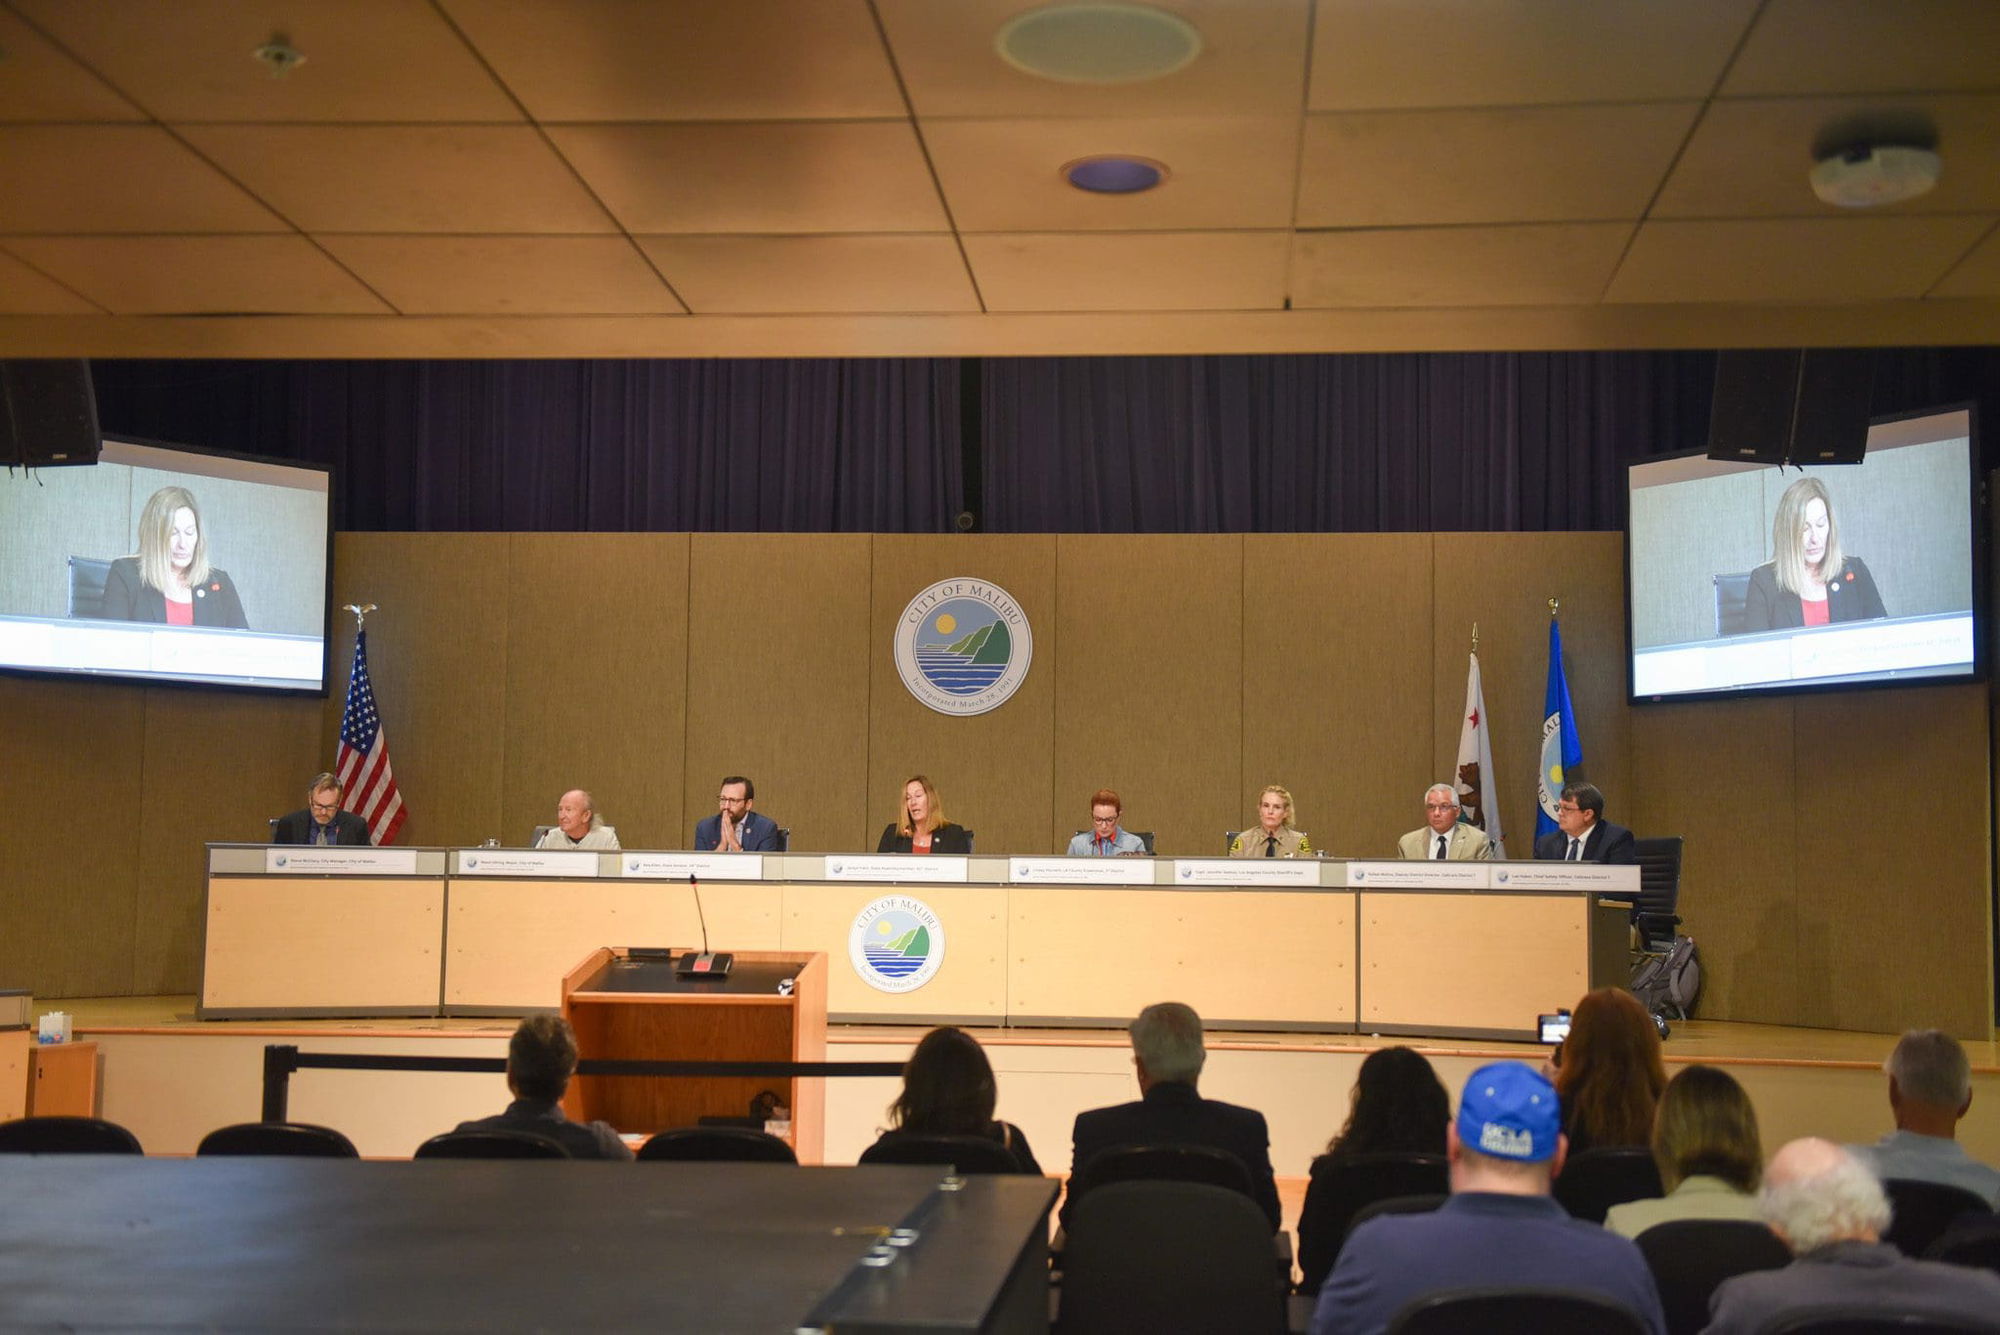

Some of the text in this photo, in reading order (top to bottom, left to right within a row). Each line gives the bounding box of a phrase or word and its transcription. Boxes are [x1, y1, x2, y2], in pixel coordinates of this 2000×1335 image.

[908, 584, 1021, 625] CITY OF MALIBU
[912, 677, 956, 707] Incorporated
[959, 698, 984, 708] March
[857, 898, 938, 930] CITY OF MALIBU
